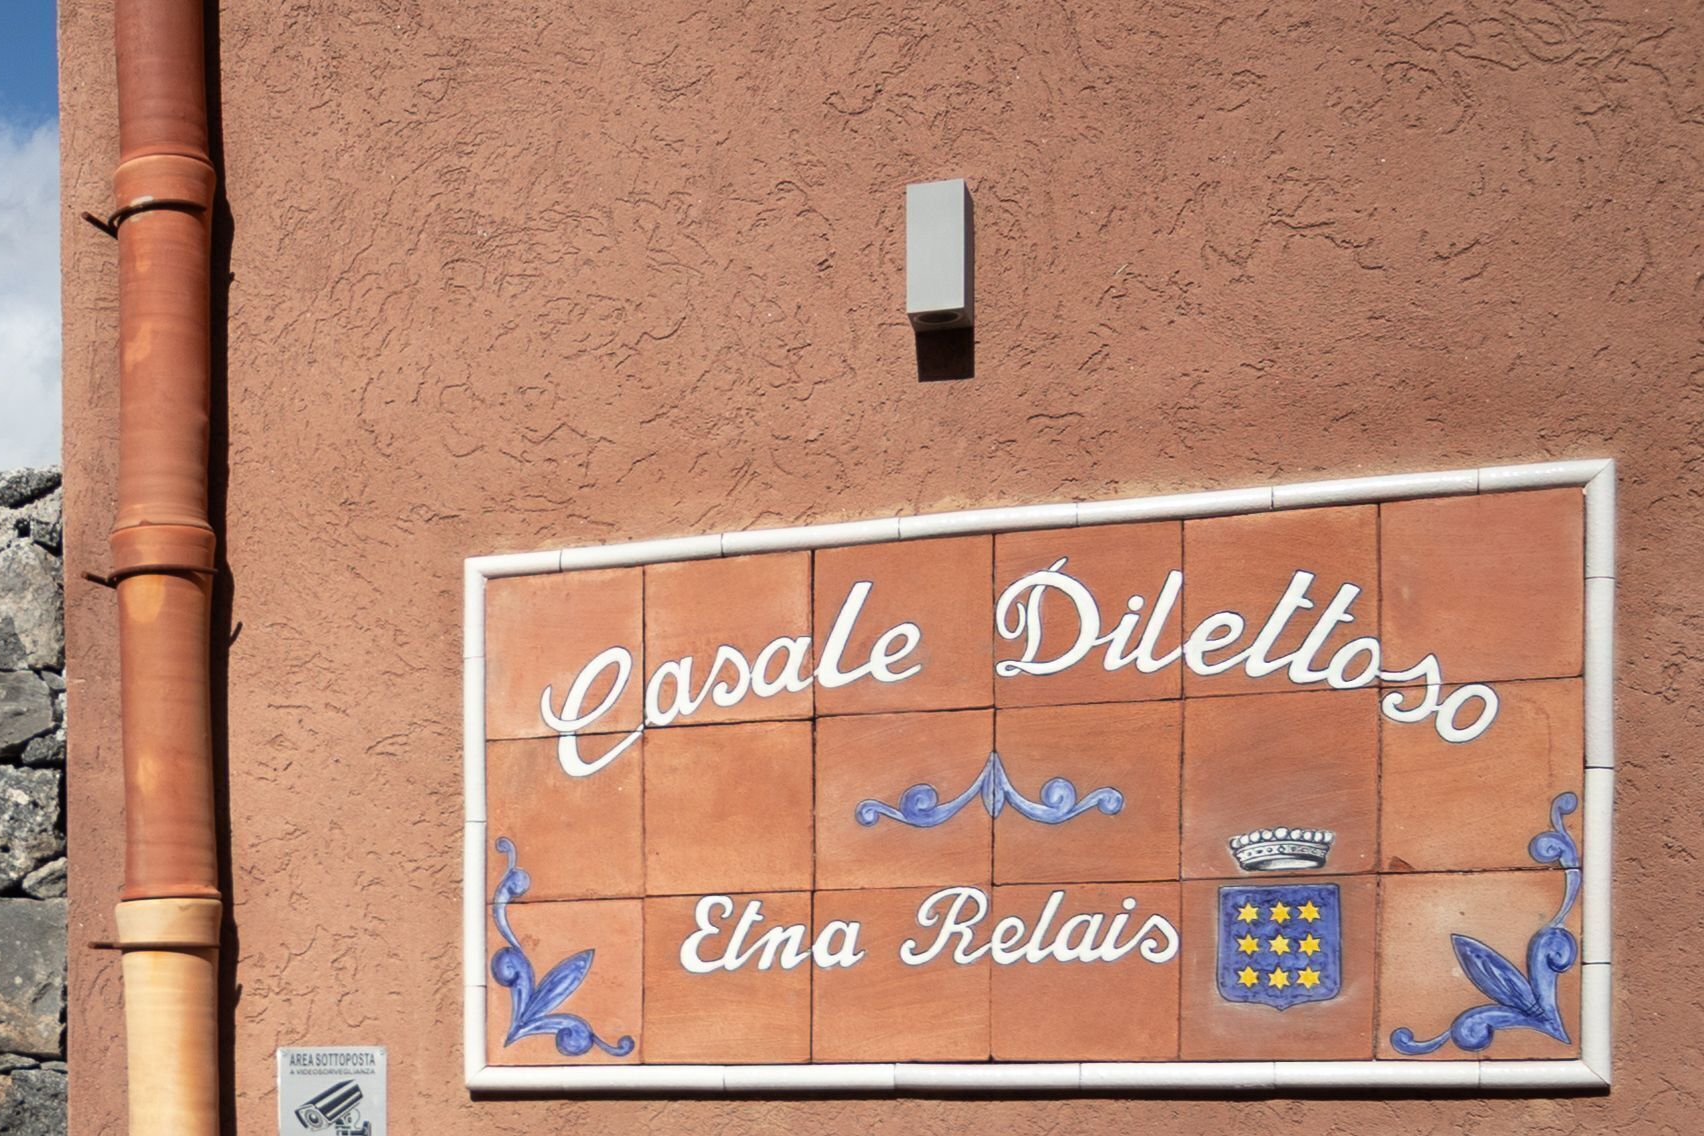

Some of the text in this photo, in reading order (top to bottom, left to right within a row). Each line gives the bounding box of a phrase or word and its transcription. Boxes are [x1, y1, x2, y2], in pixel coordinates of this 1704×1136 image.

[541, 557, 1500, 779] Casale Dilettoso
[679, 885, 1180, 974] Etna Relais
[289, 1052, 376, 1066] AREA SOTTOPOSTA
